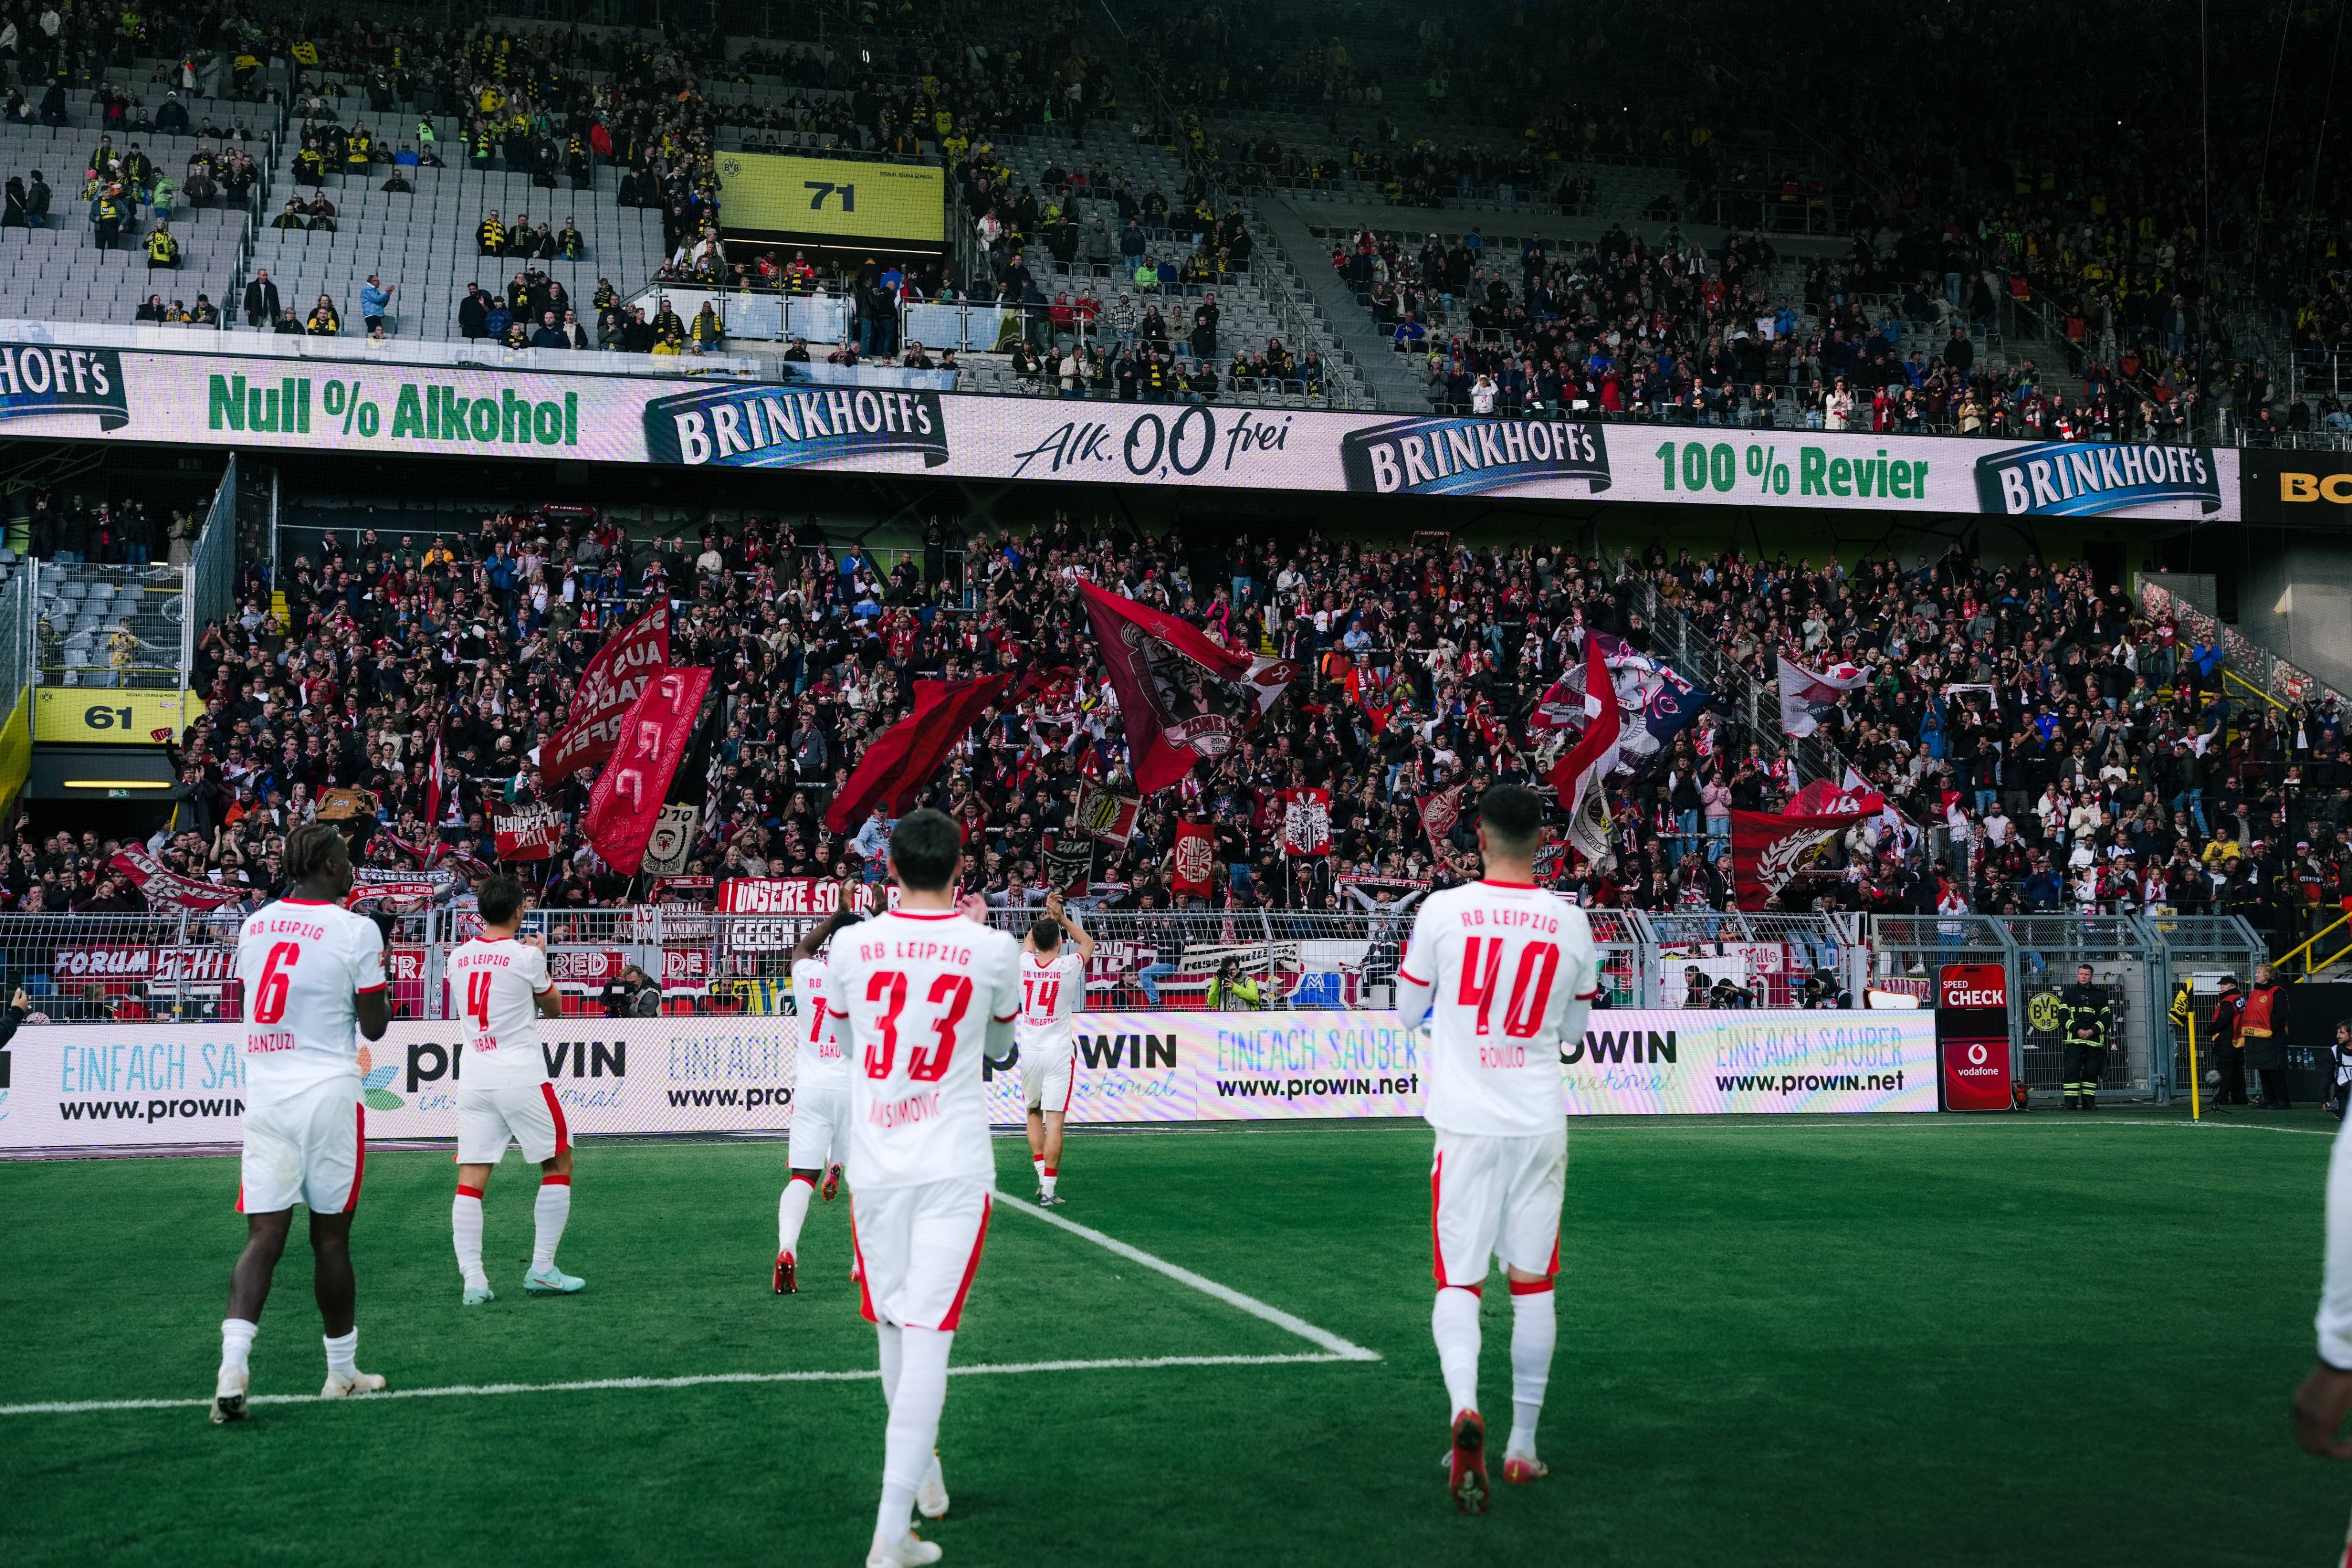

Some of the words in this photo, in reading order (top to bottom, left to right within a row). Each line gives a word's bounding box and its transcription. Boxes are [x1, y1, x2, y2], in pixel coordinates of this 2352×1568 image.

[804, 181, 854, 212] 71
[209, 374, 311, 434] Null
[324, 379, 379, 438] %
[391, 384, 578, 446] Alkohol
[1013, 422, 1113, 478] Alk.
[1124, 406, 1216, 480] 0,0
[1227, 412, 1292, 471] frei
[1655, 442, 1736, 493] 100
[1747, 444, 1790, 495] %
[1800, 446, 1929, 500] Revier
[84, 706, 132, 729] 61
[1581, 828, 1601, 851] LIPSIA
[735, 880, 808, 913] UNSERE
[250, 921, 264, 937] RB
[270, 920, 324, 940] LEIPZIG
[732, 919, 795, 951] GEGEN
[1461, 909, 1484, 927] RB
[1493, 909, 1558, 934] LEIPZIG
[54, 950, 149, 974] FORUM
[458, 957, 469, 969] RB
[473, 954, 510, 967] LEIPZIG
[552, 953, 609, 977] RED
[861, 942, 885, 962] RB
[896, 940, 972, 966] LEIPZIG
[253, 942, 300, 1024] 6
[809, 978, 822, 988] RB
[1458, 936, 1560, 1039] 40
[1943, 981, 1968, 989] SPEED
[1948, 989, 2003, 1005] CHECK
[467, 971, 491, 1032] 4
[1023, 980, 1059, 1017] 14
[864, 971, 974, 1082] 33
[2041, 1019, 2051, 1027] 09
[248, 1033, 296, 1053] BANZUZI
[1217, 1029, 1316, 1072] EINFACH
[1330, 1028, 1418, 1071] SAUBER
[1716, 1027, 1809, 1069] EINFACH
[1821, 1027, 1903, 1067] SAUBER
[63, 1043, 185, 1092] EINFACH
[201, 1042, 245, 1091] SA
[1958, 1067, 1999, 1076] vodafone
